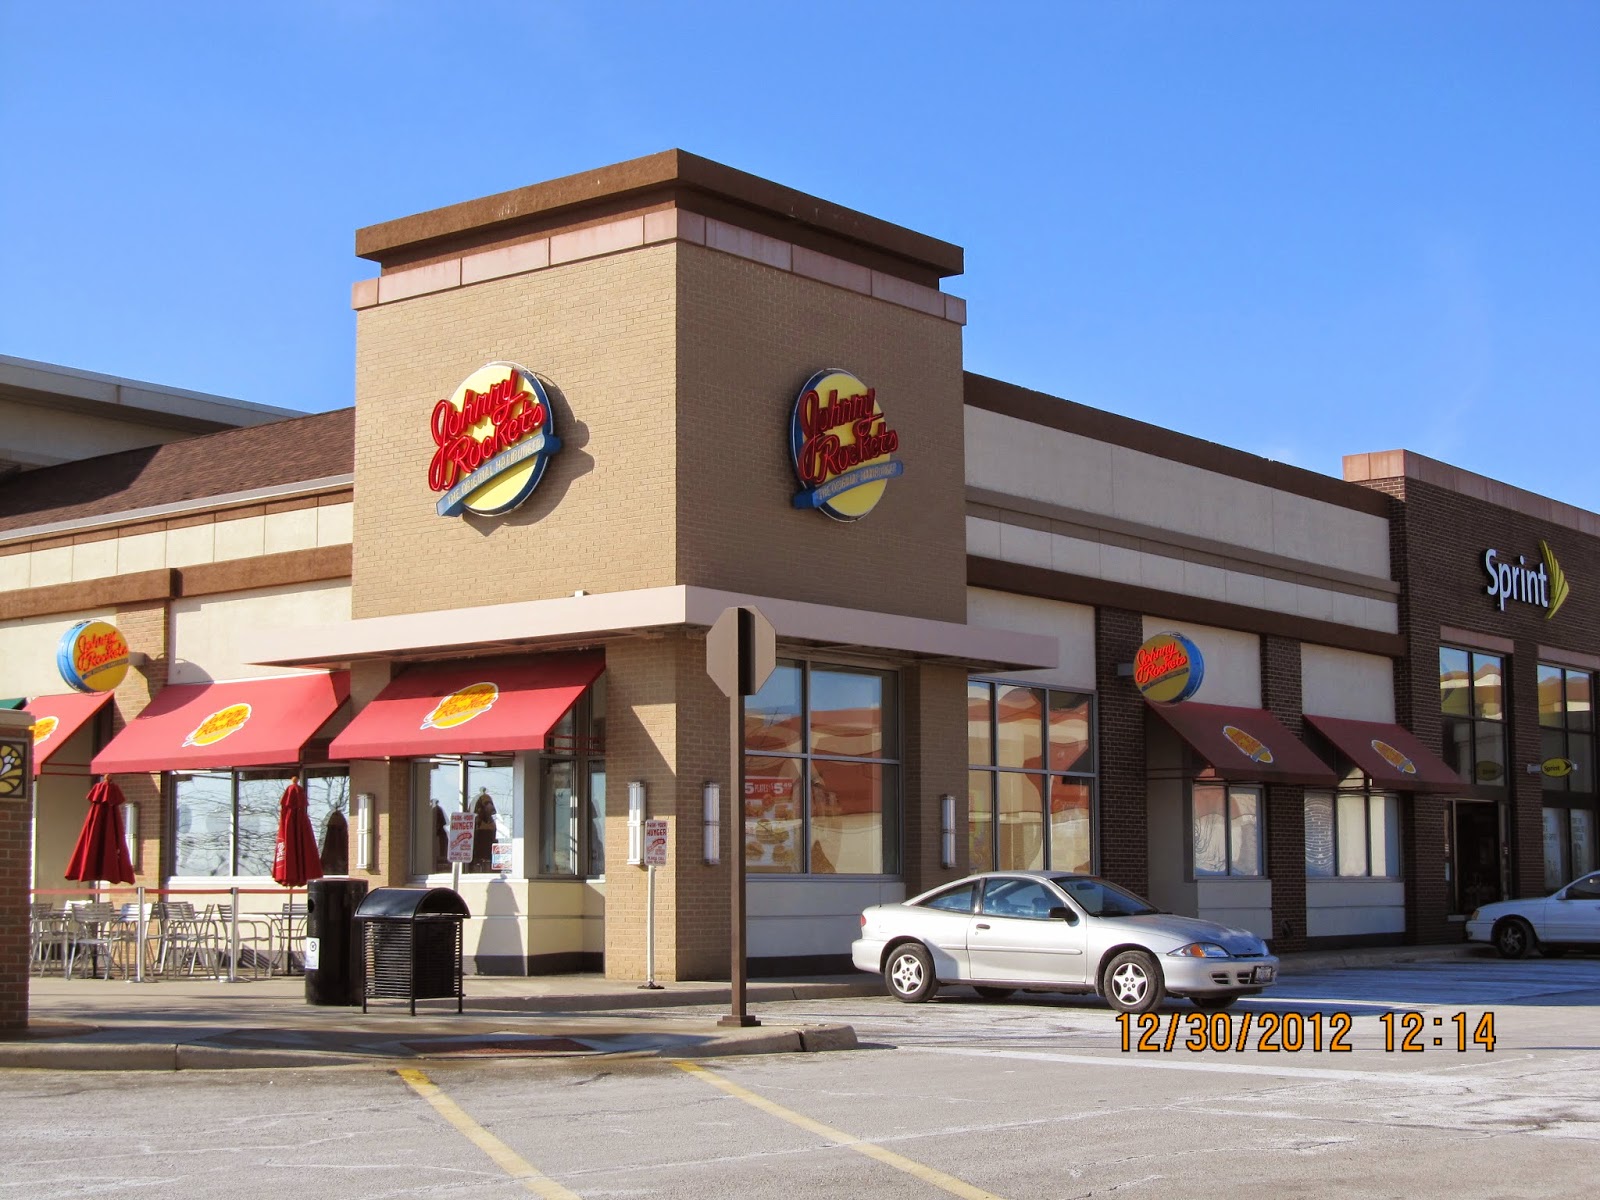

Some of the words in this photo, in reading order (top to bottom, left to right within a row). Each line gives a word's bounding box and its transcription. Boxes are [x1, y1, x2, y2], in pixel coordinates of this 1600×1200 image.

[429, 368, 533, 491] Johnny
[443, 399, 547, 490] Rockets
[799, 388, 884, 479] Johnny
[813, 421, 899, 484] Rockets
[461, 465, 493, 497] ORIGINAL
[495, 438, 542, 472] HAMBURGER
[1485, 548, 1549, 612] Sprint
[78, 631, 117, 671] Johnny
[86, 642, 129, 671] Rockets
[1136, 642, 1179, 682] Johnny
[1142, 653, 1188, 683] Rockets
[451, 822, 473, 830] HUNGER
